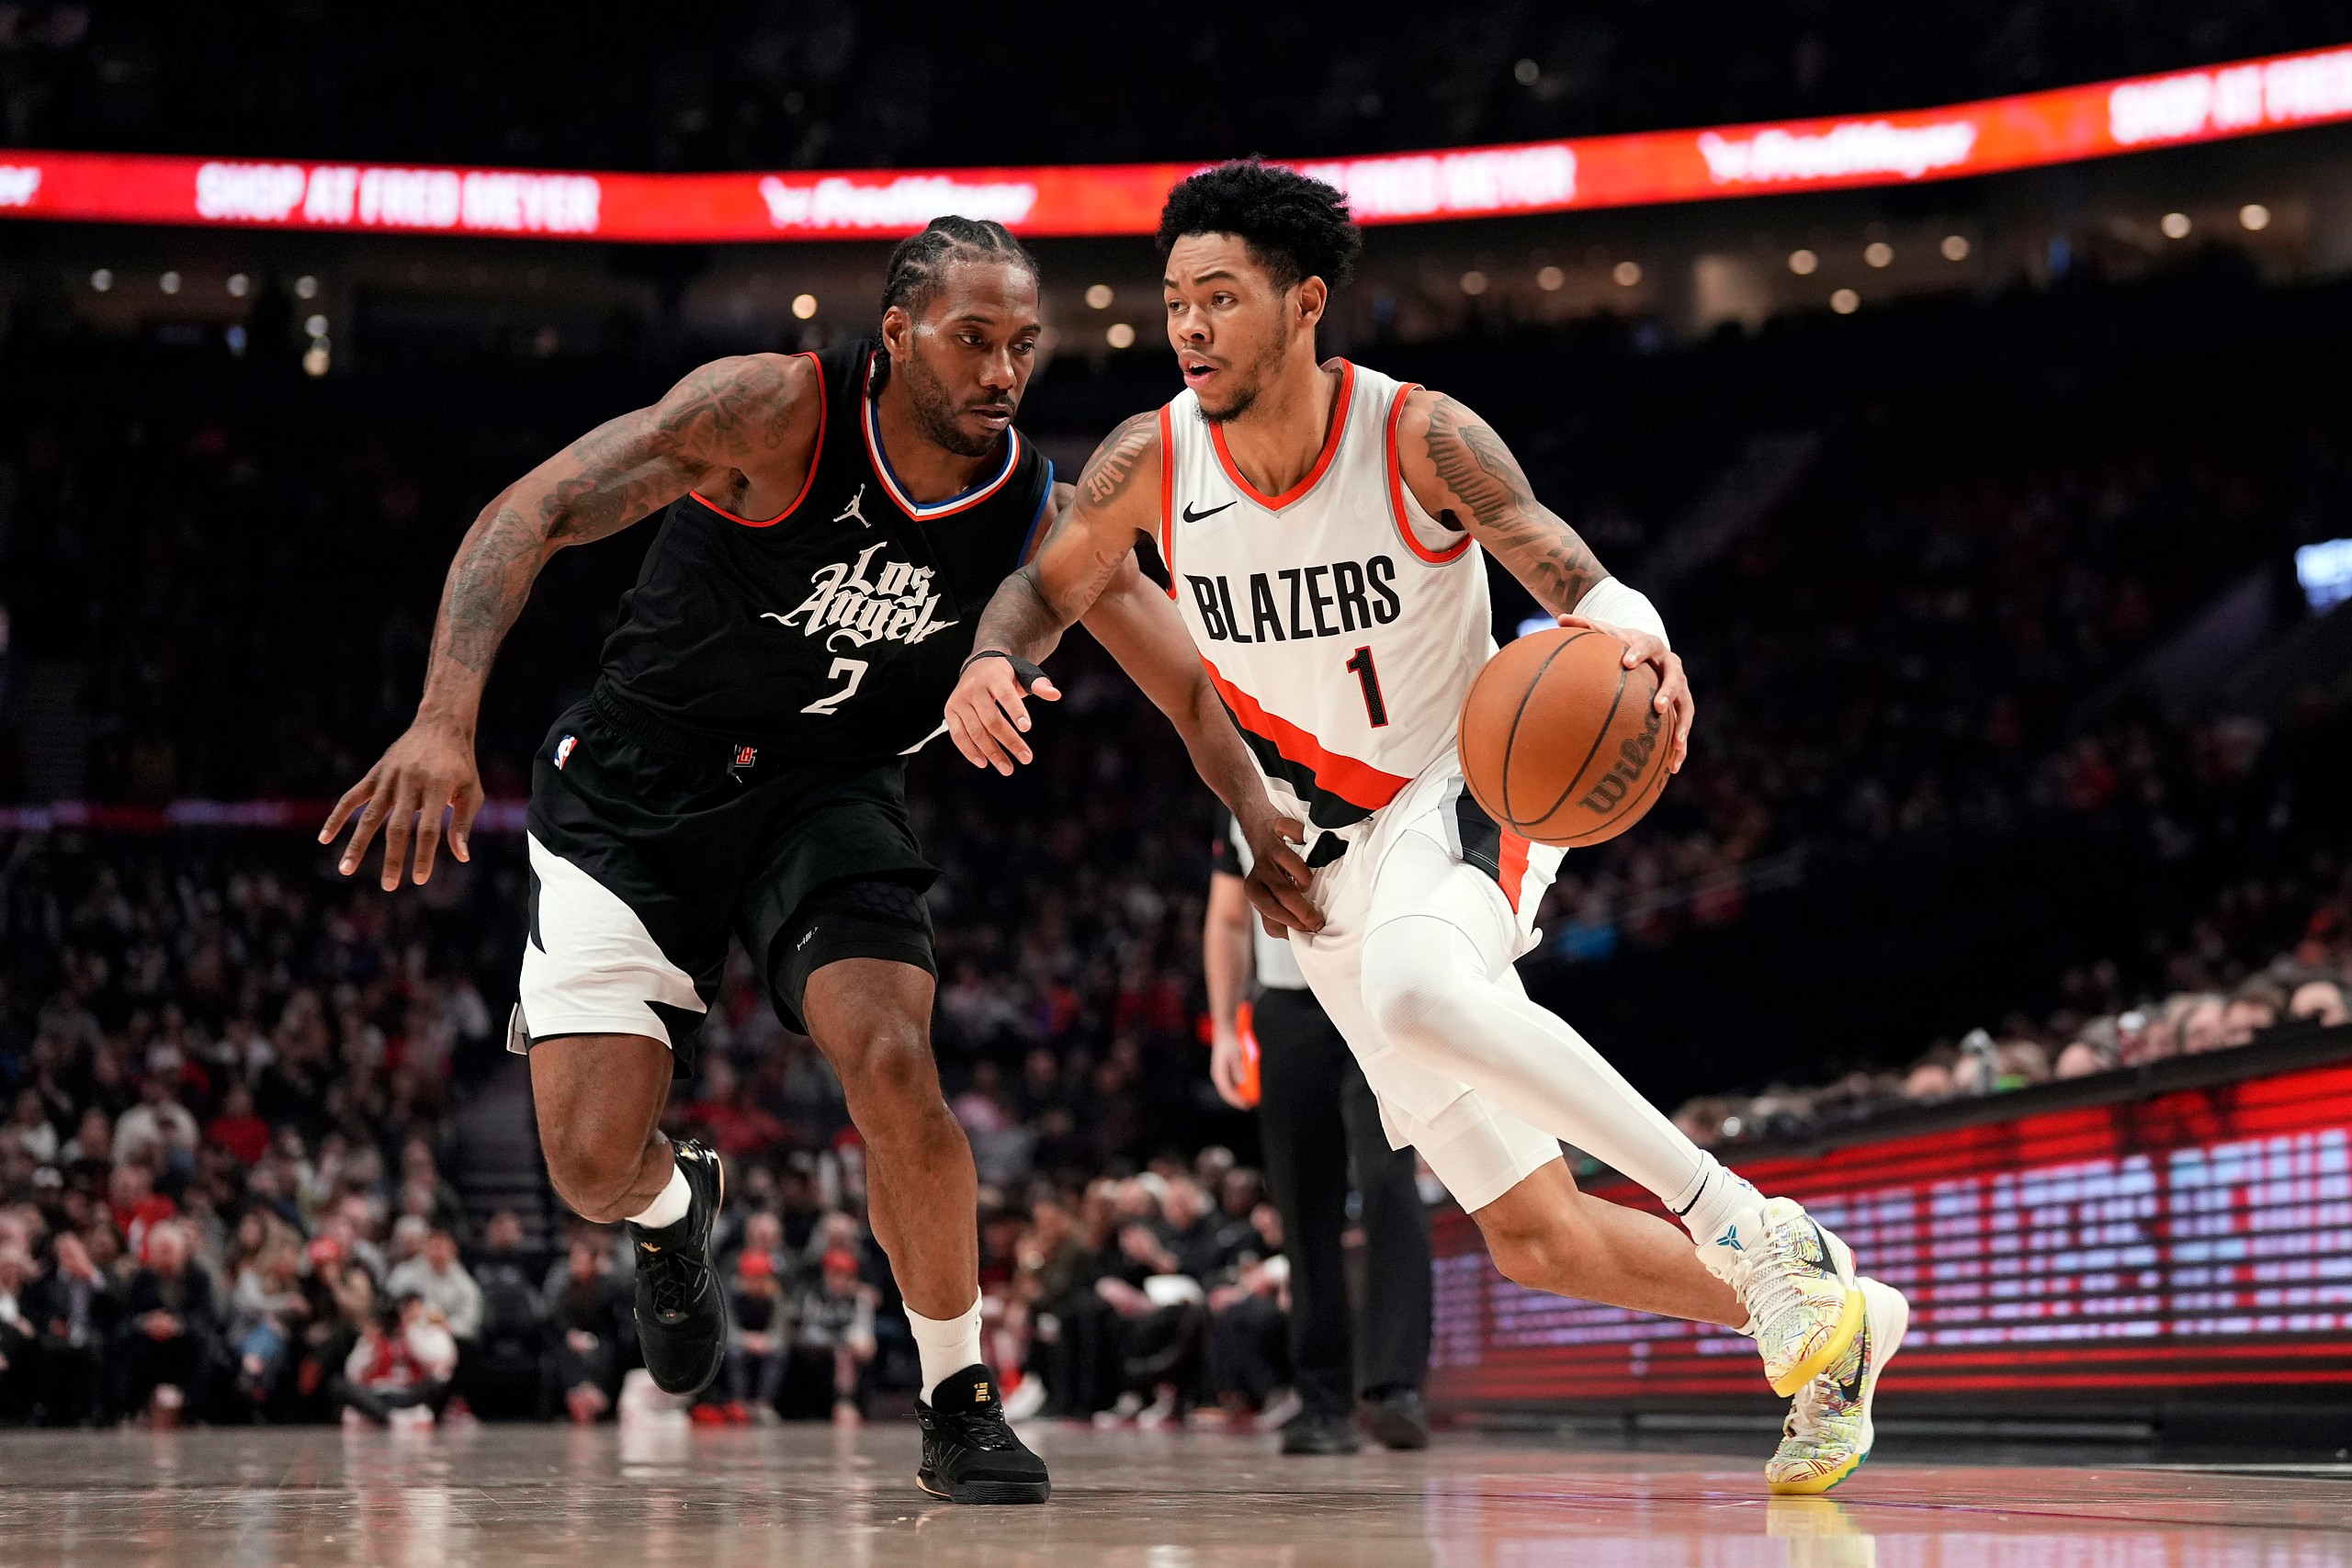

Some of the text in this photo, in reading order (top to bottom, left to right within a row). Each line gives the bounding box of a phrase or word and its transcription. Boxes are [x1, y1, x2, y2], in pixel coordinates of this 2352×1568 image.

[839, 541, 935, 606] Los
[1182, 555, 1401, 644] BLAZERS
[800, 657, 869, 716] 2
[1346, 646, 1389, 728] 1
[1576, 691, 1662, 815] Wilso
